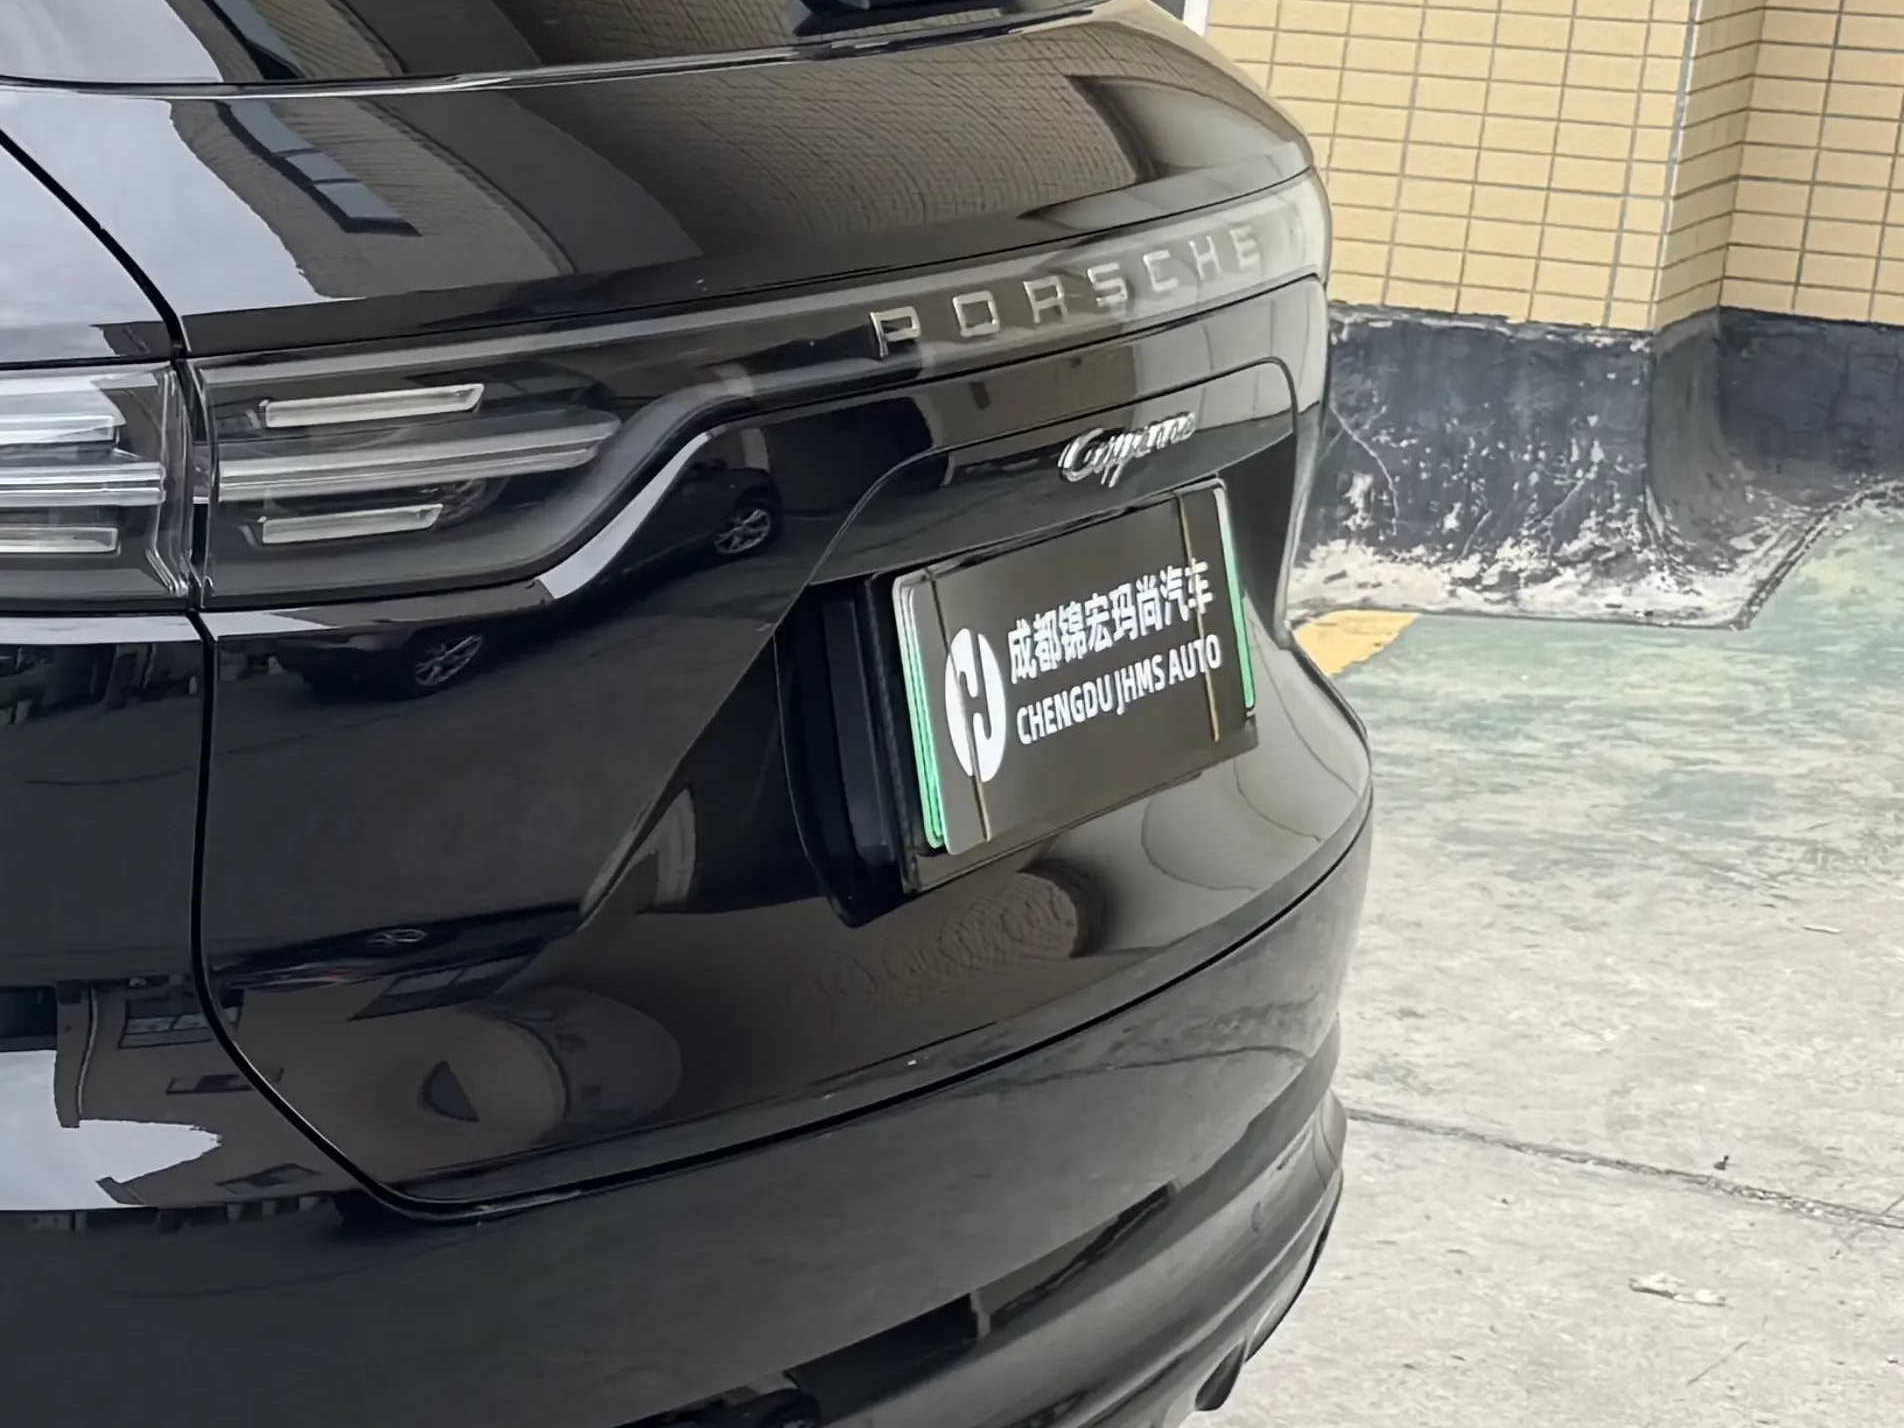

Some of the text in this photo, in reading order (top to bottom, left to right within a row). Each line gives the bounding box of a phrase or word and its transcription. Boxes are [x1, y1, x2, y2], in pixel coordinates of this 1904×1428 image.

[869, 225, 1261, 358] PORSCHE
[1007, 557, 1214, 684] 成都锦宏玛尚汽车
[1016, 634, 1222, 745] CHENGDU JHMS AUTO
